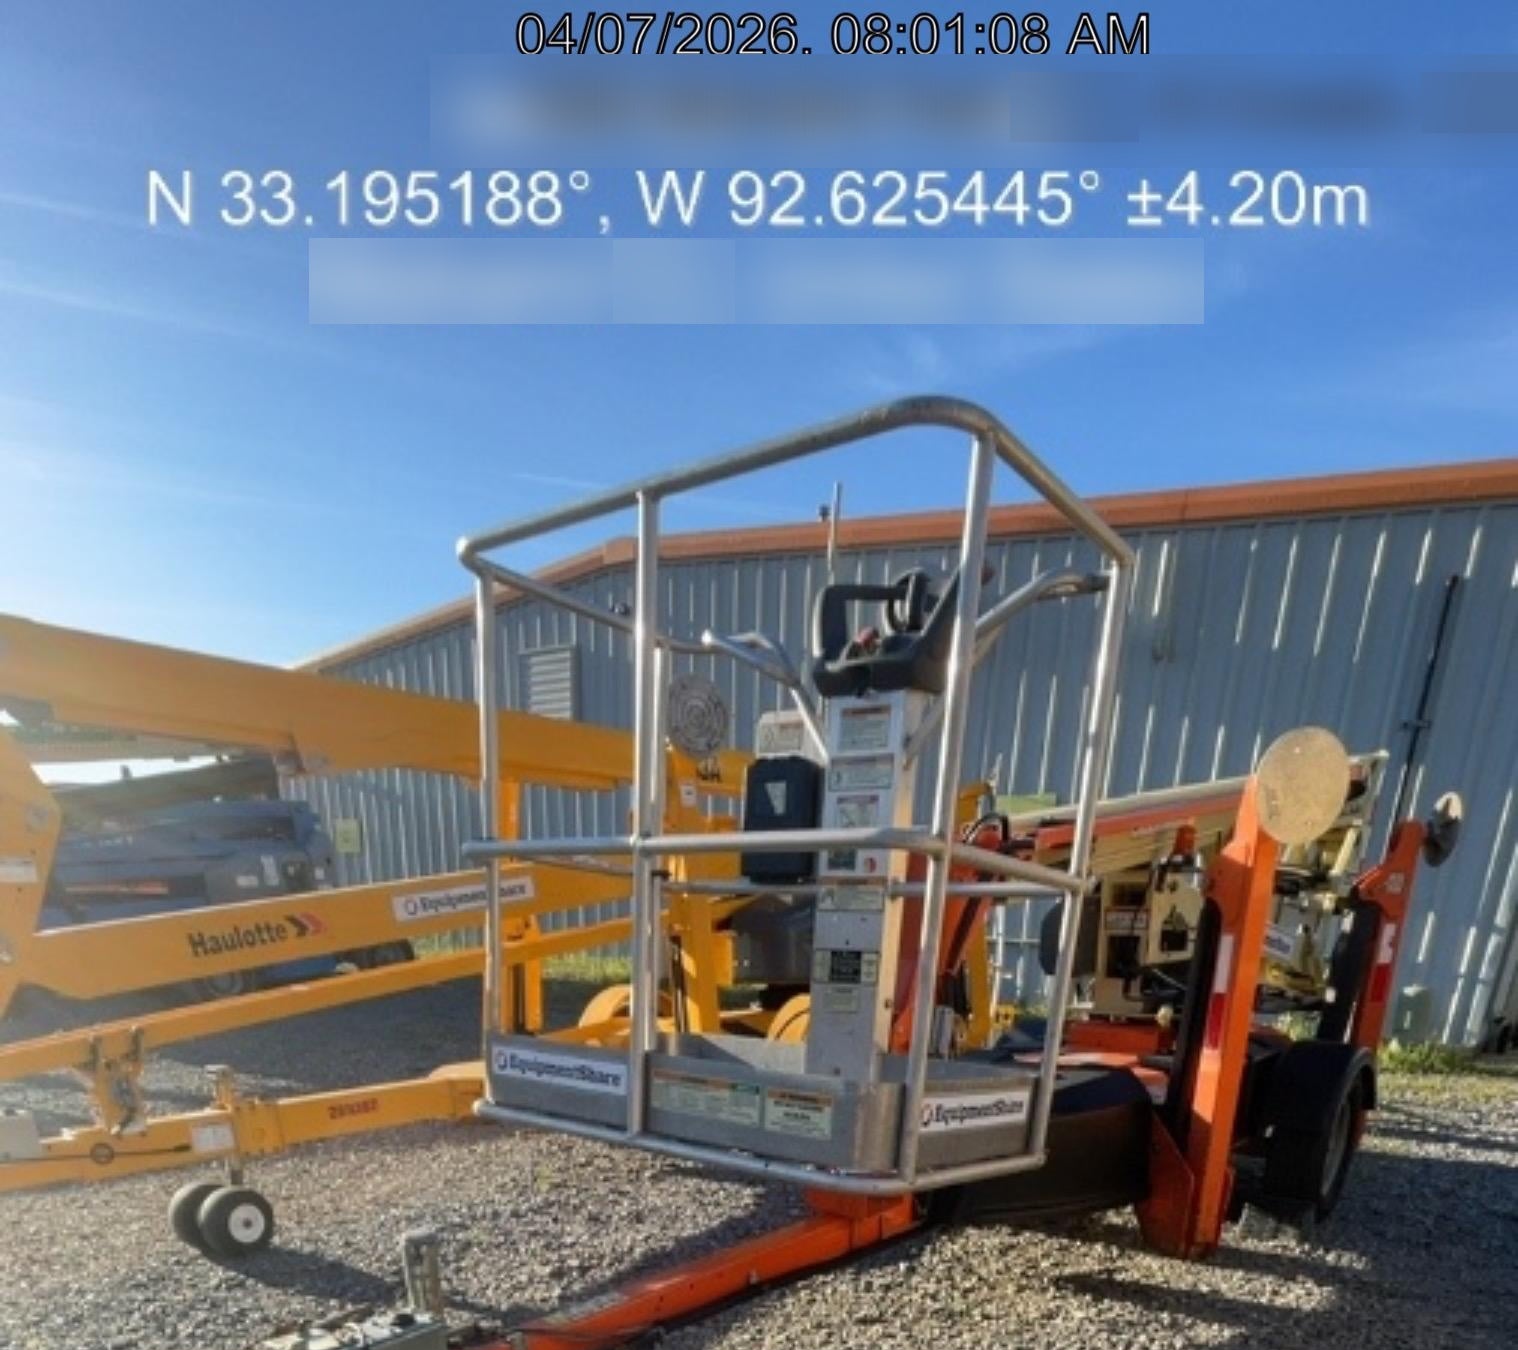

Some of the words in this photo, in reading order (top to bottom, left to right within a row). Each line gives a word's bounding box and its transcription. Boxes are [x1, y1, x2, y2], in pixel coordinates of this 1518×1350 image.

[187, 922, 288, 957] Haulotte
[509, 1052, 621, 1087] EquipmentShare
[935, 1098, 1024, 1126] EquipmentShare
